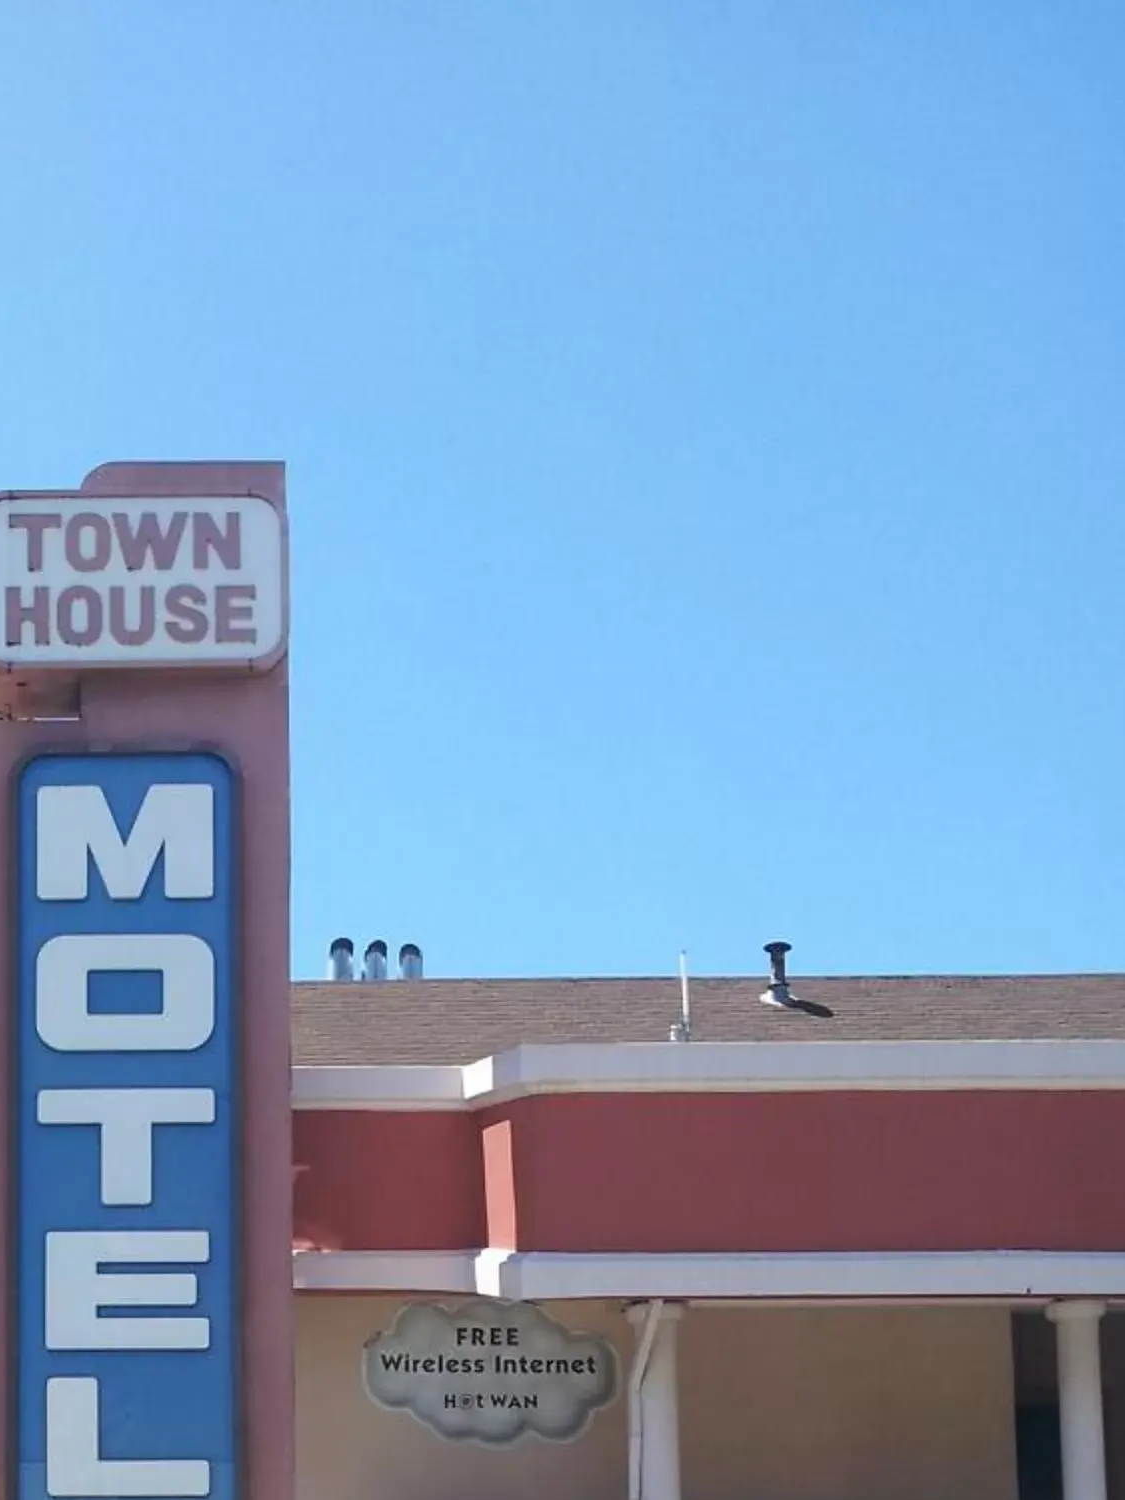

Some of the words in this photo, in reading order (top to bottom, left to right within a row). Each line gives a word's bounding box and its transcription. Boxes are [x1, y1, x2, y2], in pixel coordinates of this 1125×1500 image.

[8, 511, 241, 572] TOWN
[5, 584, 257, 647] HOUSE
[35, 783, 216, 1499] MOTEL
[381, 1353, 485, 1375] Wireless
[494, 1354, 597, 1375] Internet
[456, 1327, 520, 1347] FREE
